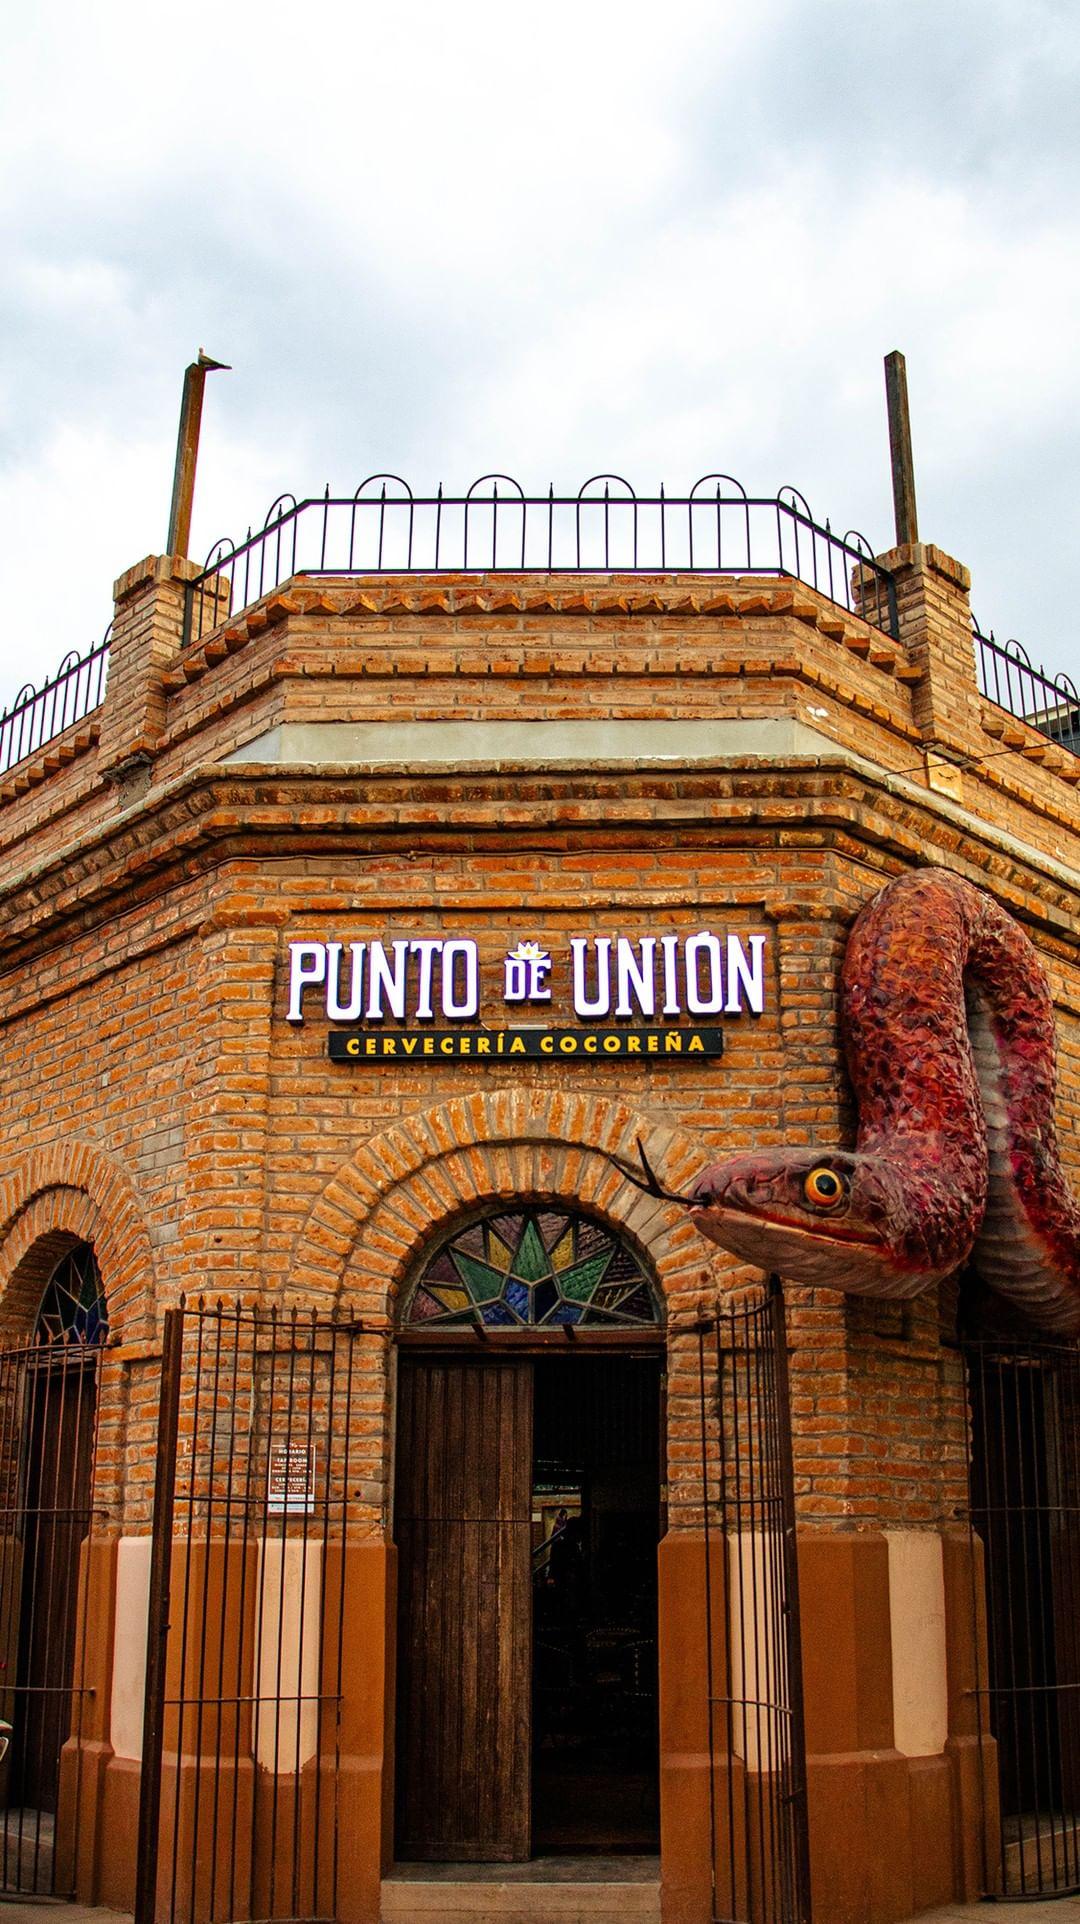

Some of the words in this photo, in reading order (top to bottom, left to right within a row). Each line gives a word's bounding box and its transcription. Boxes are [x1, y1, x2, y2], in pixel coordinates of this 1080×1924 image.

[286, 939, 479, 1021] PUNTO
[504, 959, 551, 1001] DE
[570, 931, 766, 1016] UNIÓN
[346, 1032, 526, 1054] CERVECERÍA
[540, 1031, 705, 1053] COCOREÑA
